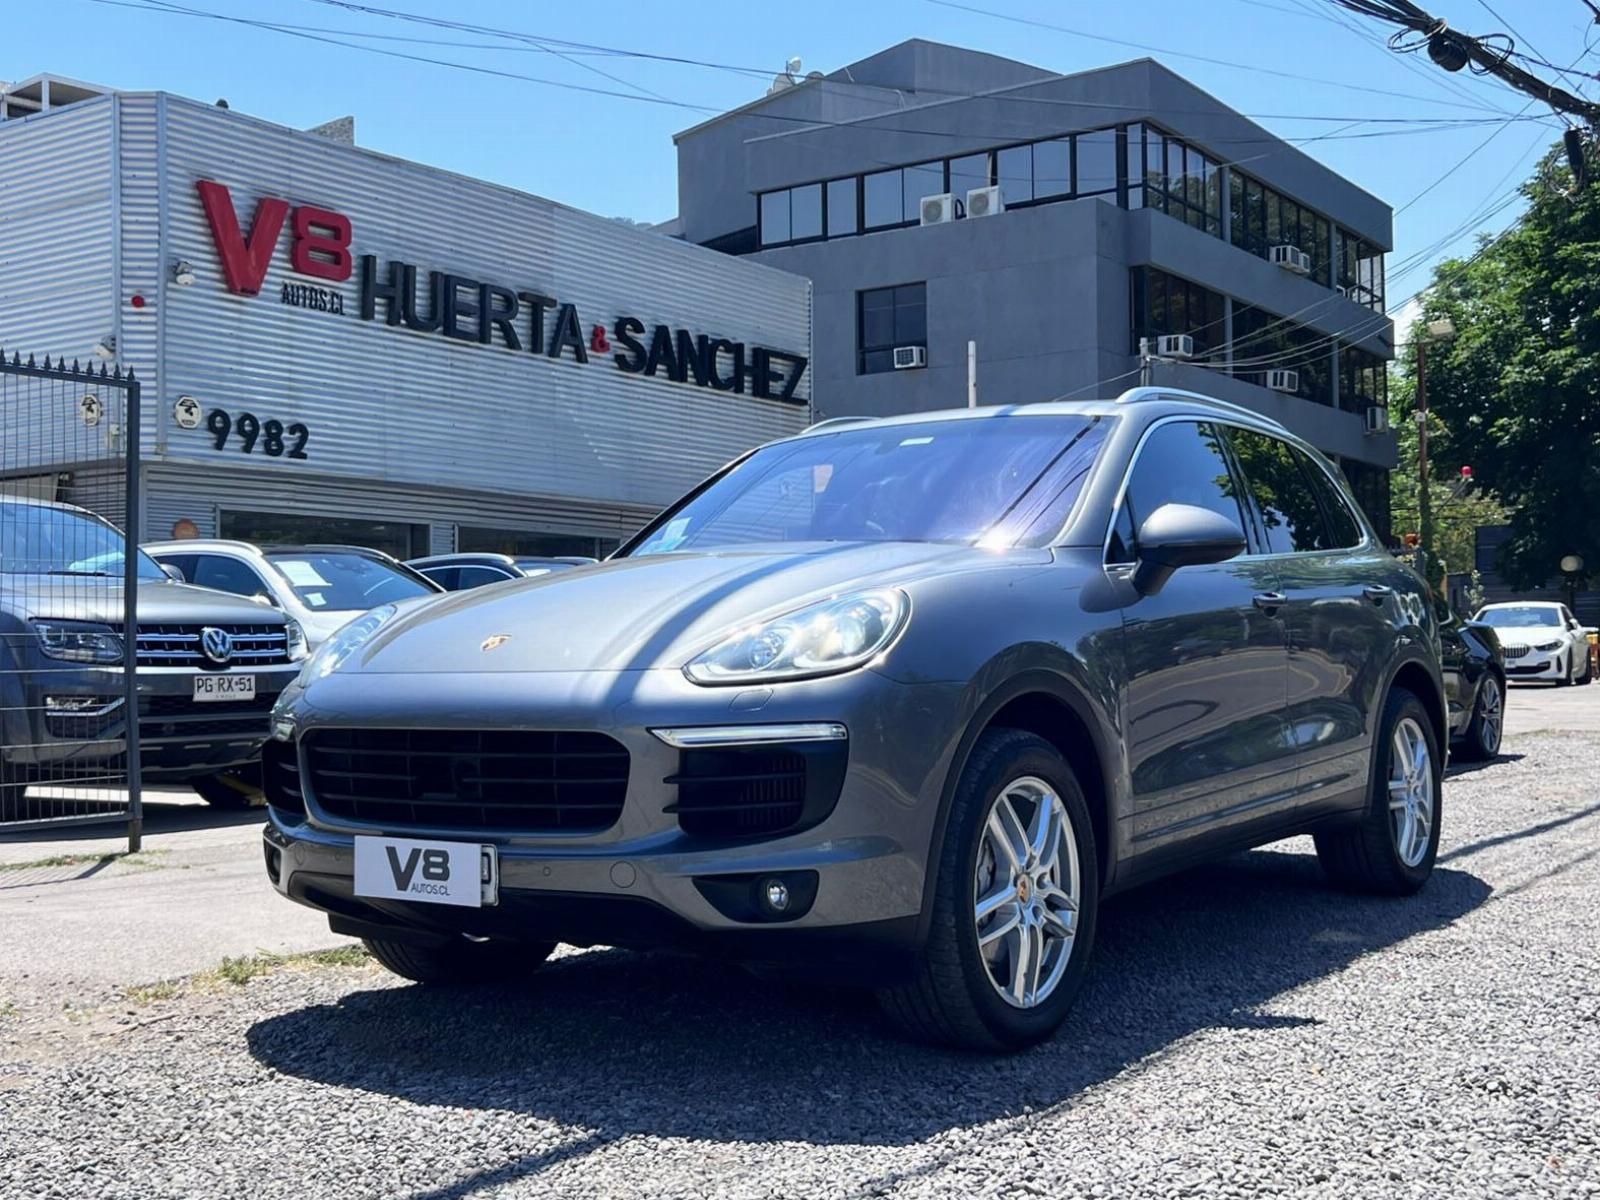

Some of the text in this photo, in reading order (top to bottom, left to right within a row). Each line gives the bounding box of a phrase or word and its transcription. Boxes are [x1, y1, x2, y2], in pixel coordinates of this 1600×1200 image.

[196, 179, 352, 297] V8
[281, 281, 346, 315] AUTOS.CL
[360, 254, 809, 406] HUERTA & SANCHEZ
[208, 408, 309, 460] 9982
[385, 846, 450, 892] V8
[410, 883, 451, 896] AUTOS.CL
